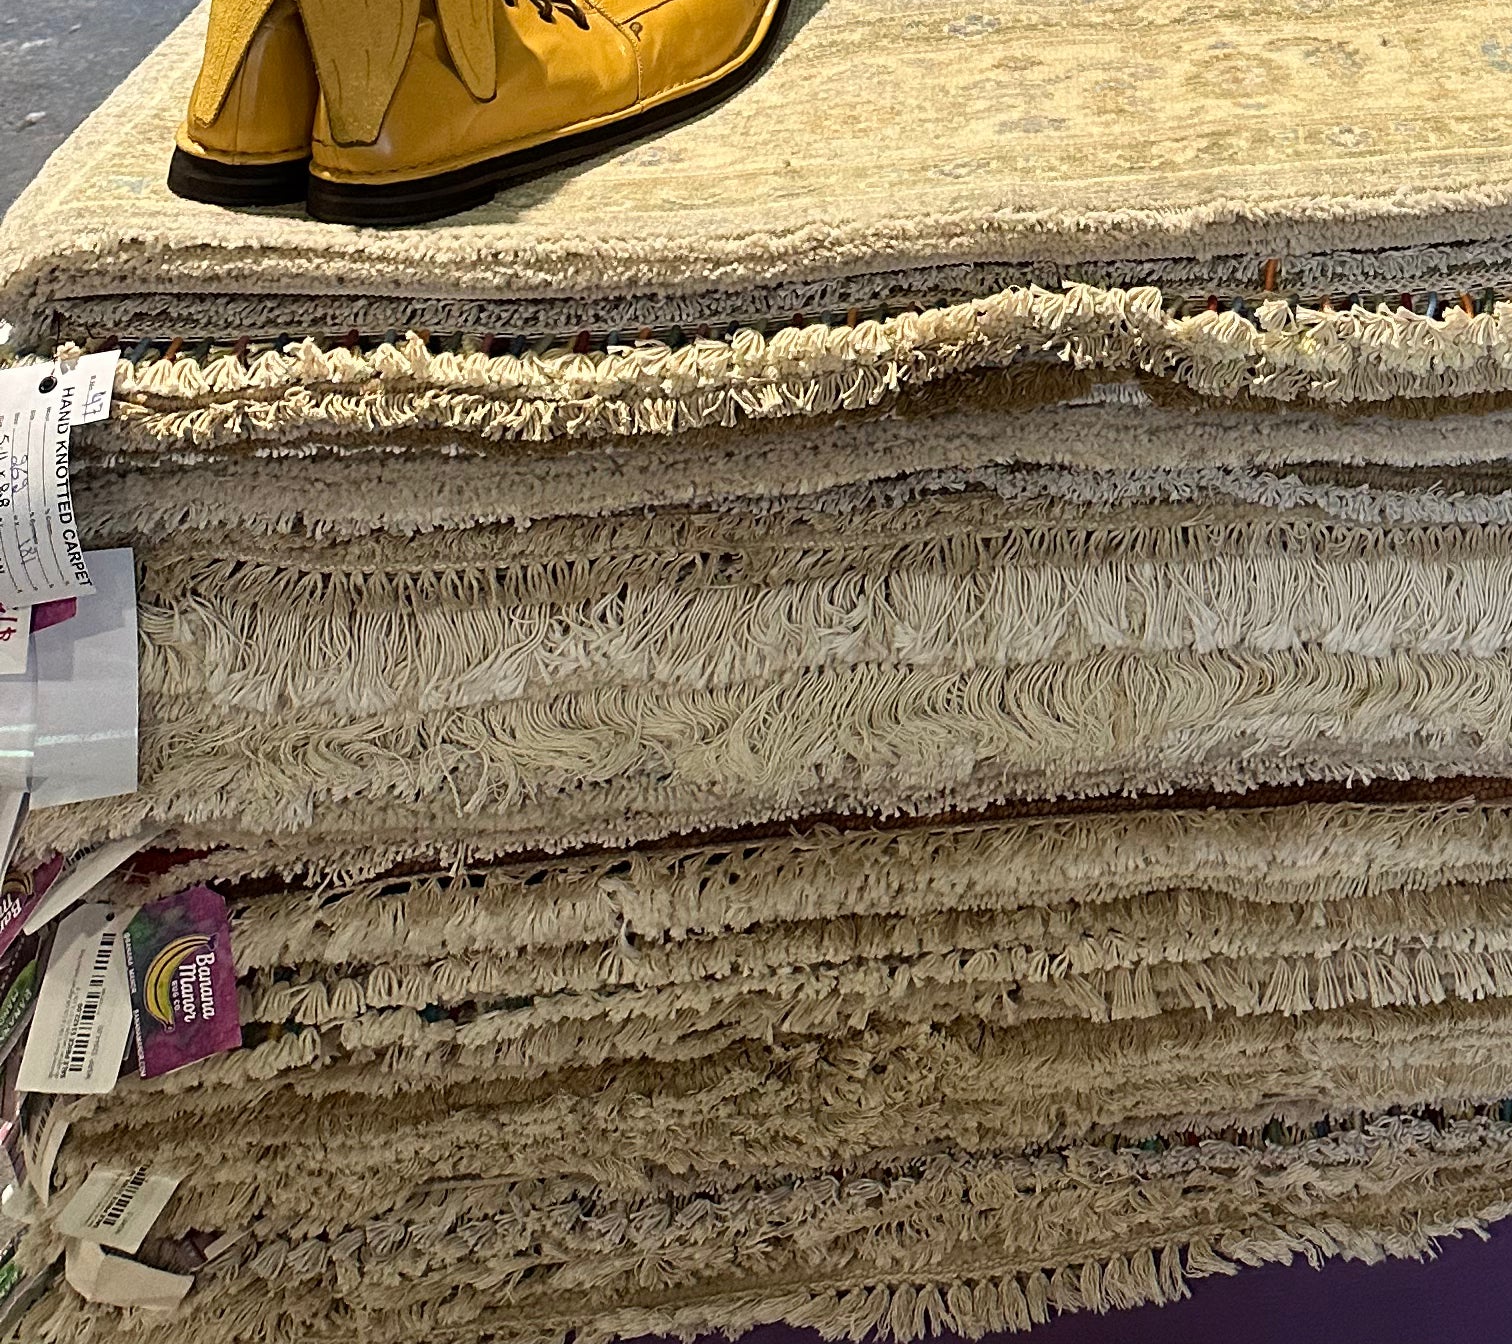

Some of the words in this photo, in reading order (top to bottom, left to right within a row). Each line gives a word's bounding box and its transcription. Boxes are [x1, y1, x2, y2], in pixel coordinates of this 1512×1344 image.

[57, 386, 76, 435] HAND
[55, 440, 73, 524] KNOTTED
[62, 529, 93, 587] CARPET
[171, 980, 180, 999] RUG
[178, 963, 197, 1023] Manor
[195, 952, 215, 1020] Banana
